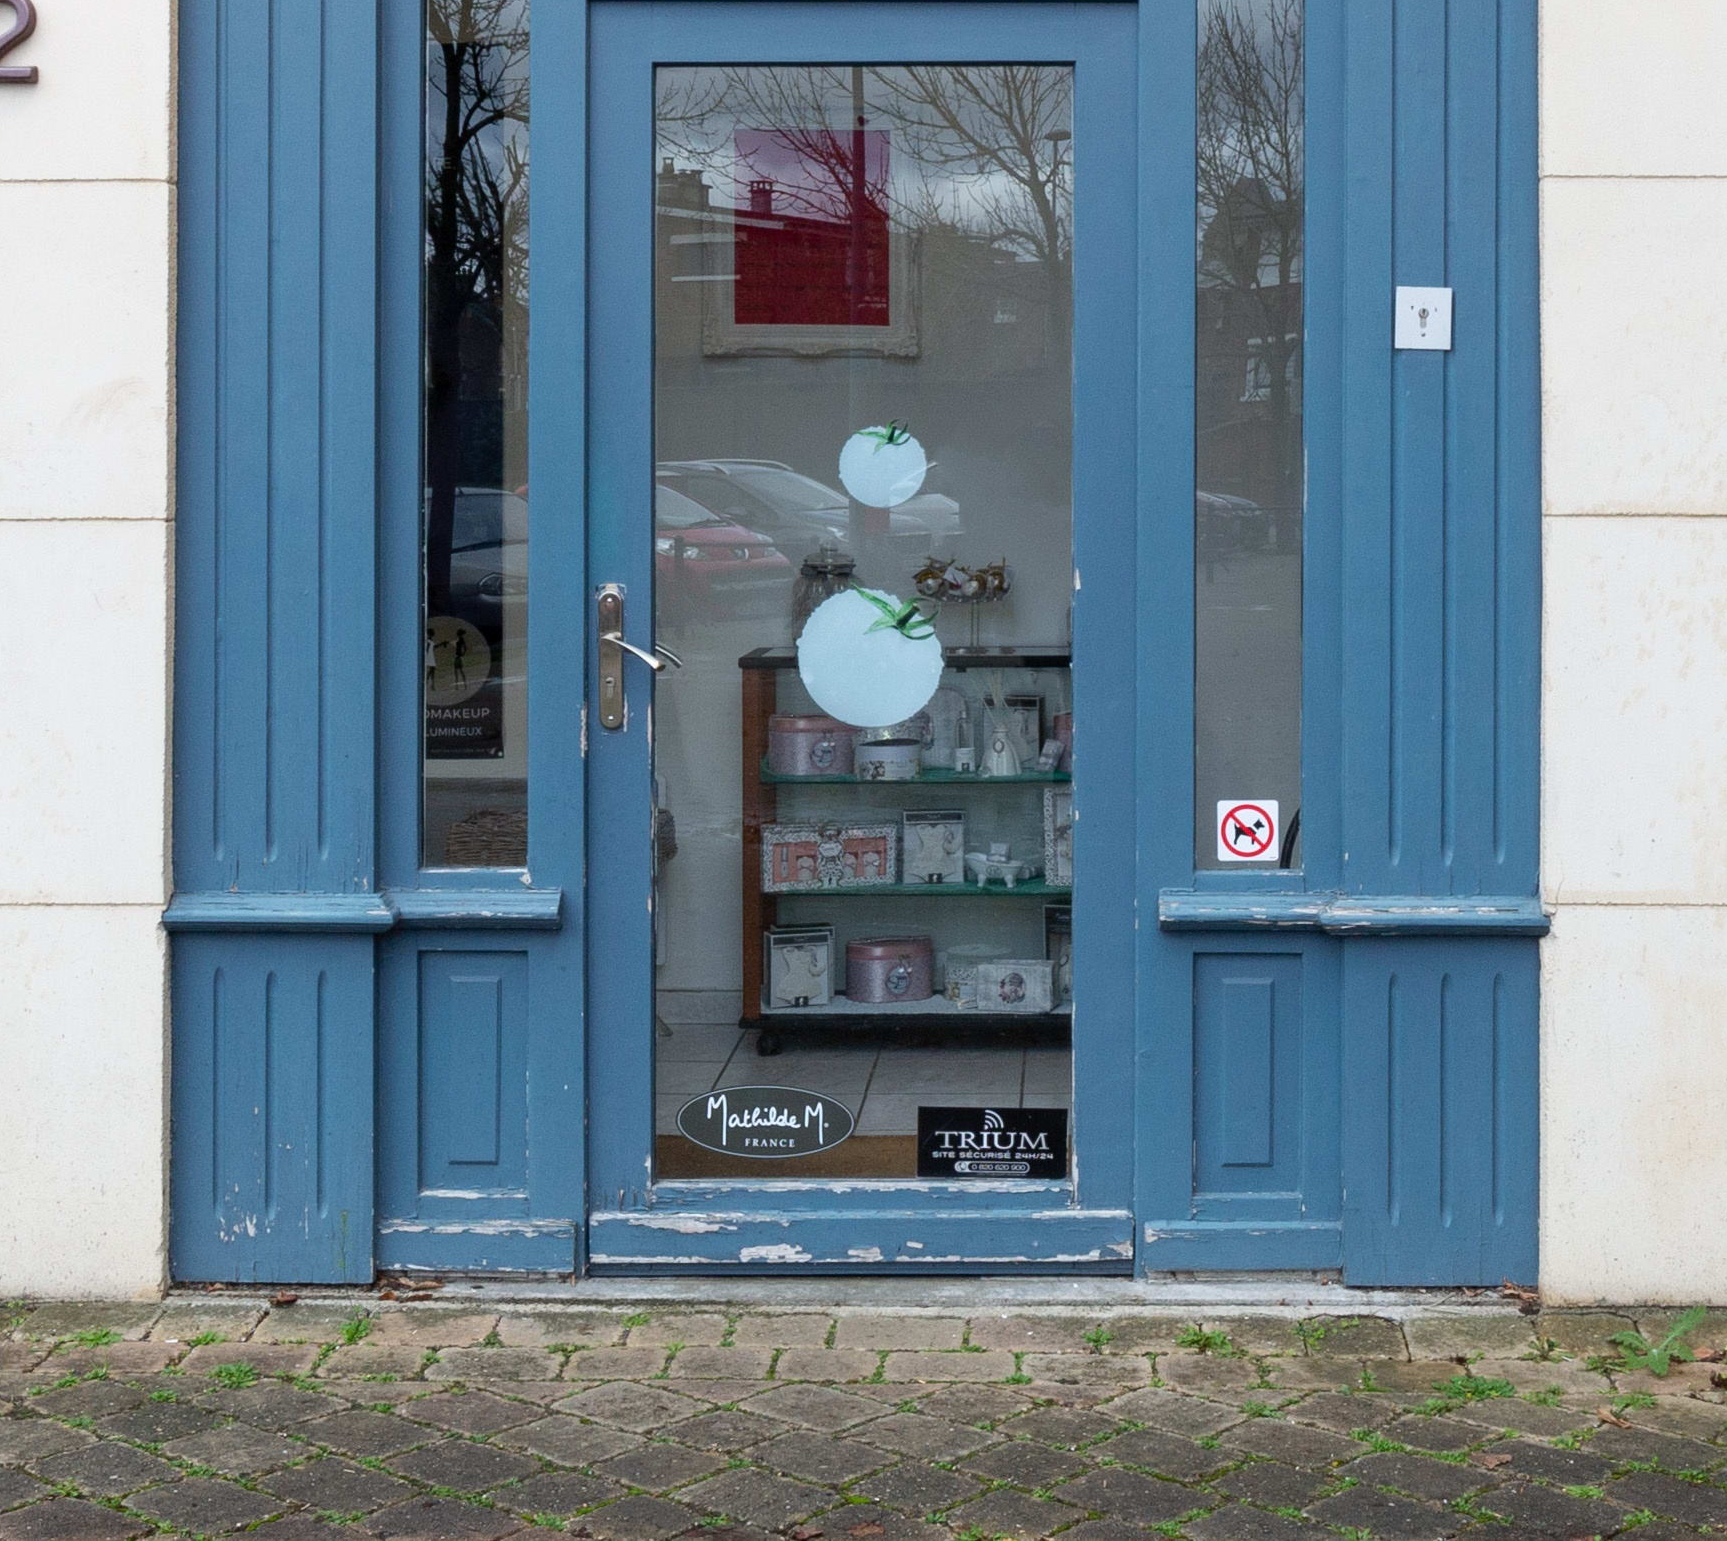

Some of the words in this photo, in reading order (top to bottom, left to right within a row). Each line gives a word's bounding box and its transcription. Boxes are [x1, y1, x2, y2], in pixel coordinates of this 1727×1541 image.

[706, 1093, 802, 1146] Mathilde
[744, 1138, 796, 1148] FRANCE
[934, 1131, 1050, 1151] TRIUM
[932, 1150, 956, 1159] SITE
[959, 1150, 1011, 1159] SÉCURISÉ
[1015, 1152, 1054, 1160] 24H/24
[971, 1163, 978, 1171] 0
